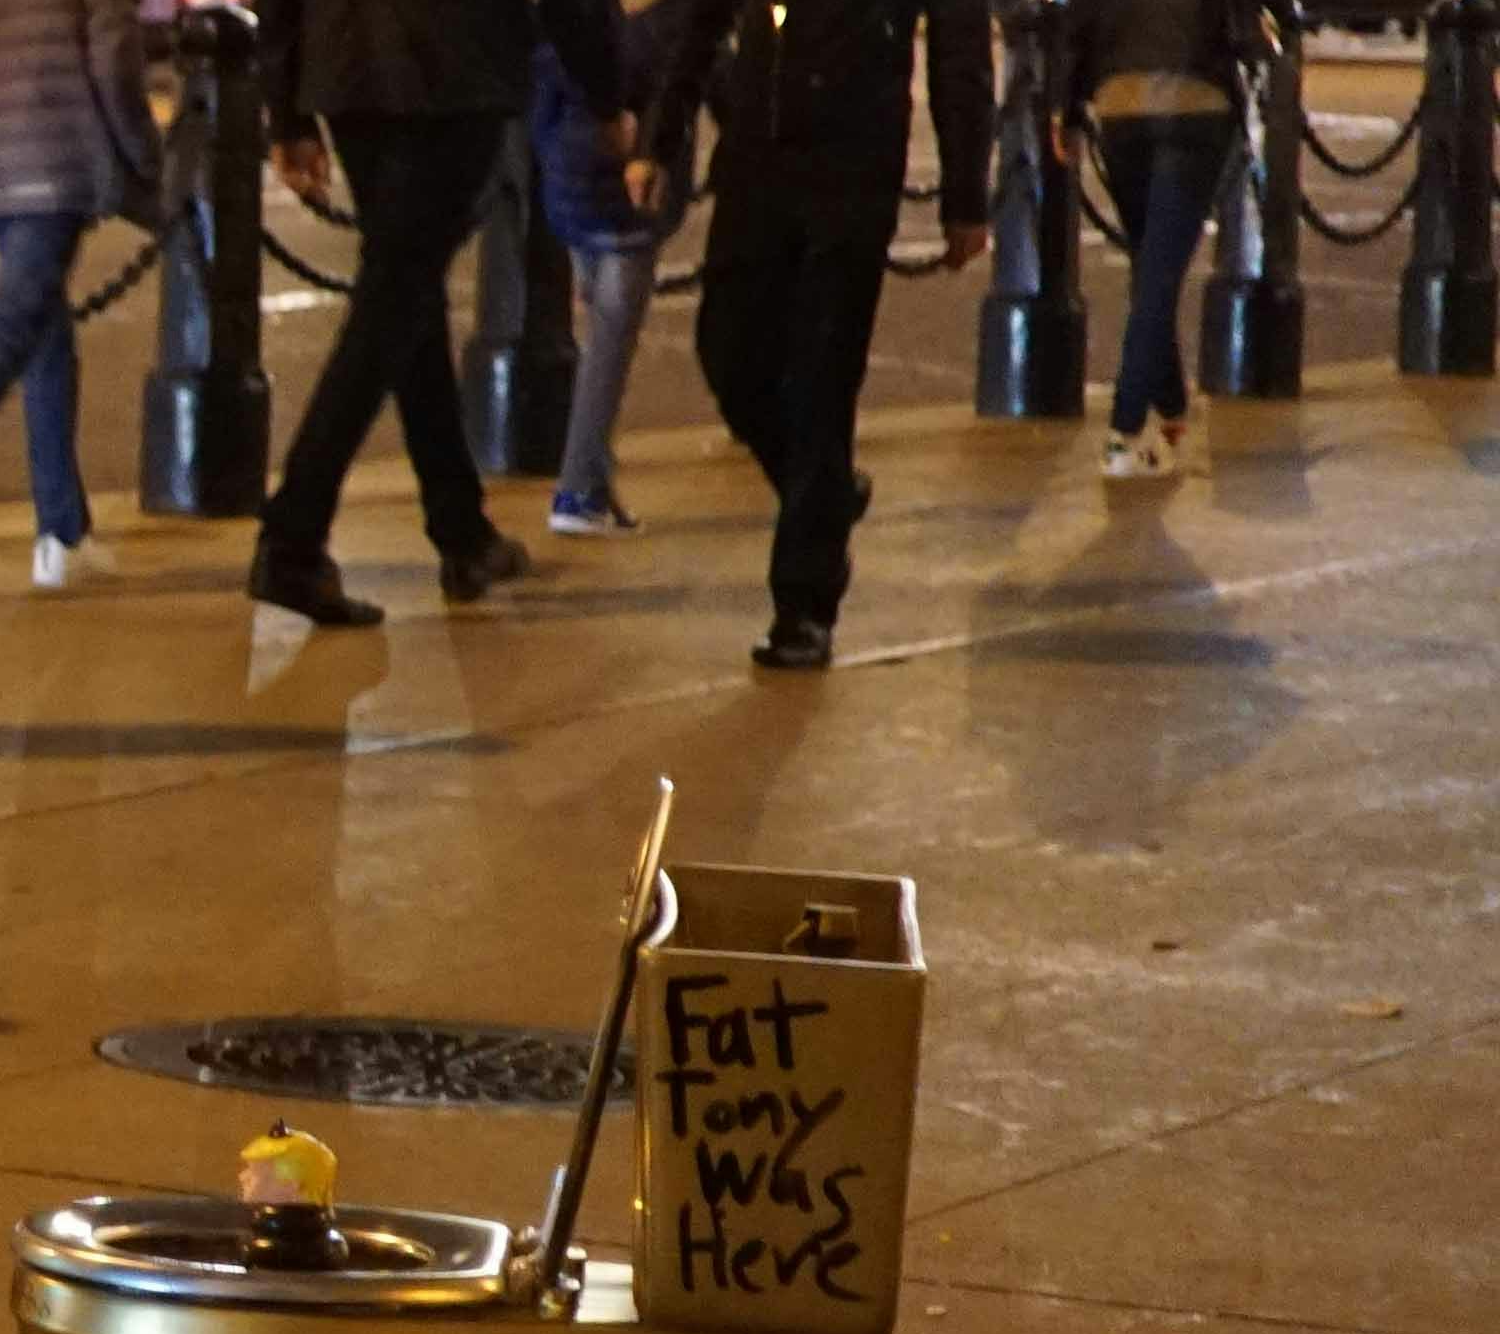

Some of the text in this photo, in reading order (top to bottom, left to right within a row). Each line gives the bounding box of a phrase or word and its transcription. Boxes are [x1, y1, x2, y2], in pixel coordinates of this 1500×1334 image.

[664, 975, 828, 1070] Fat
[656, 1068, 844, 1167] Tony
[677, 1202, 870, 1302] Here
